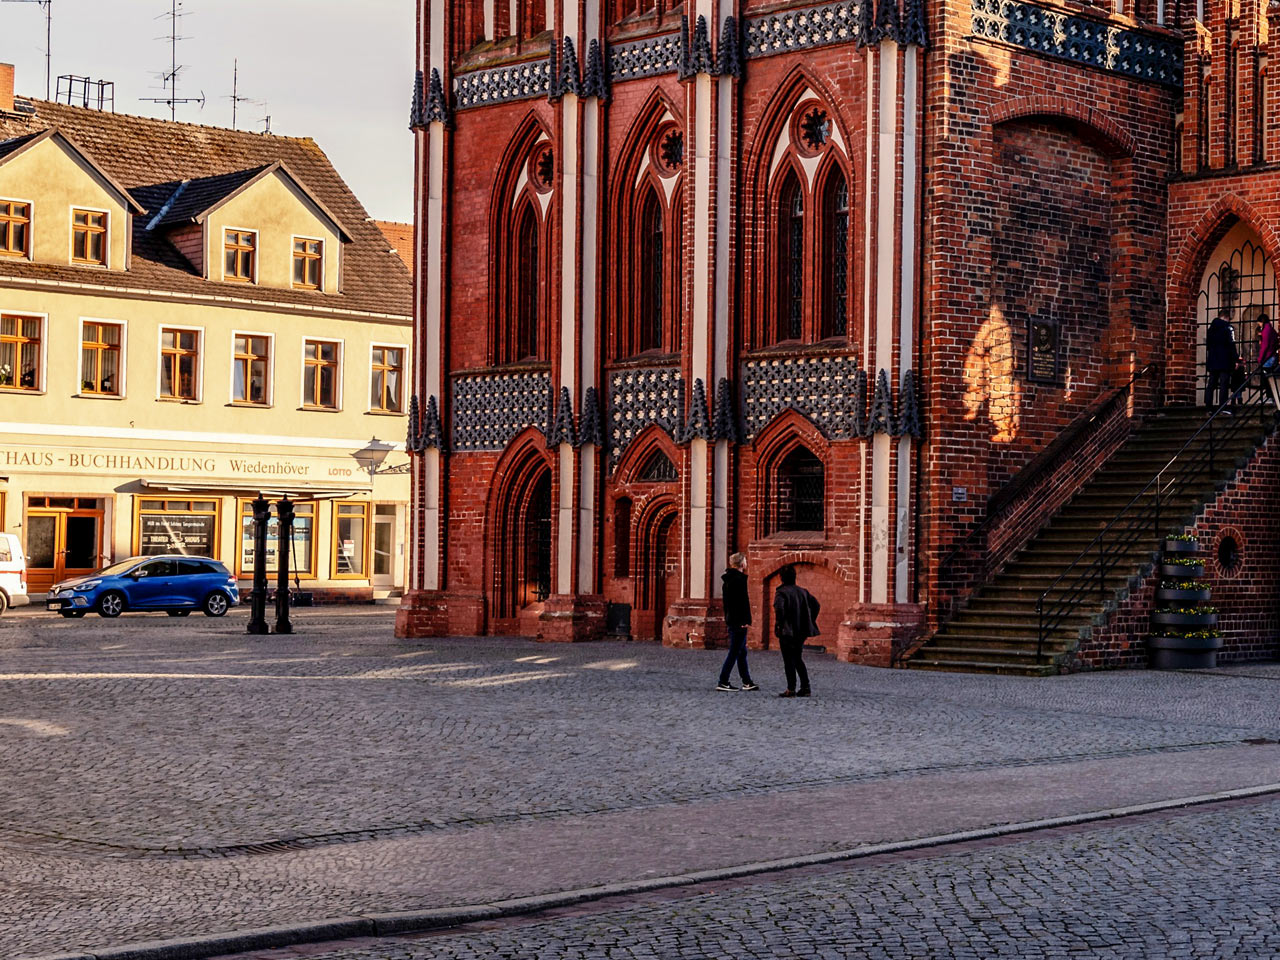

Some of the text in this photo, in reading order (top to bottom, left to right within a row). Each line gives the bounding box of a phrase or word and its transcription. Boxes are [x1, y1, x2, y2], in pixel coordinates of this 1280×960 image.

[69, 453, 216, 472] BUCHHANDLUNG
[229, 459, 309, 475] Wiedenhöver
[328, 467, 352, 477] LOTTO
